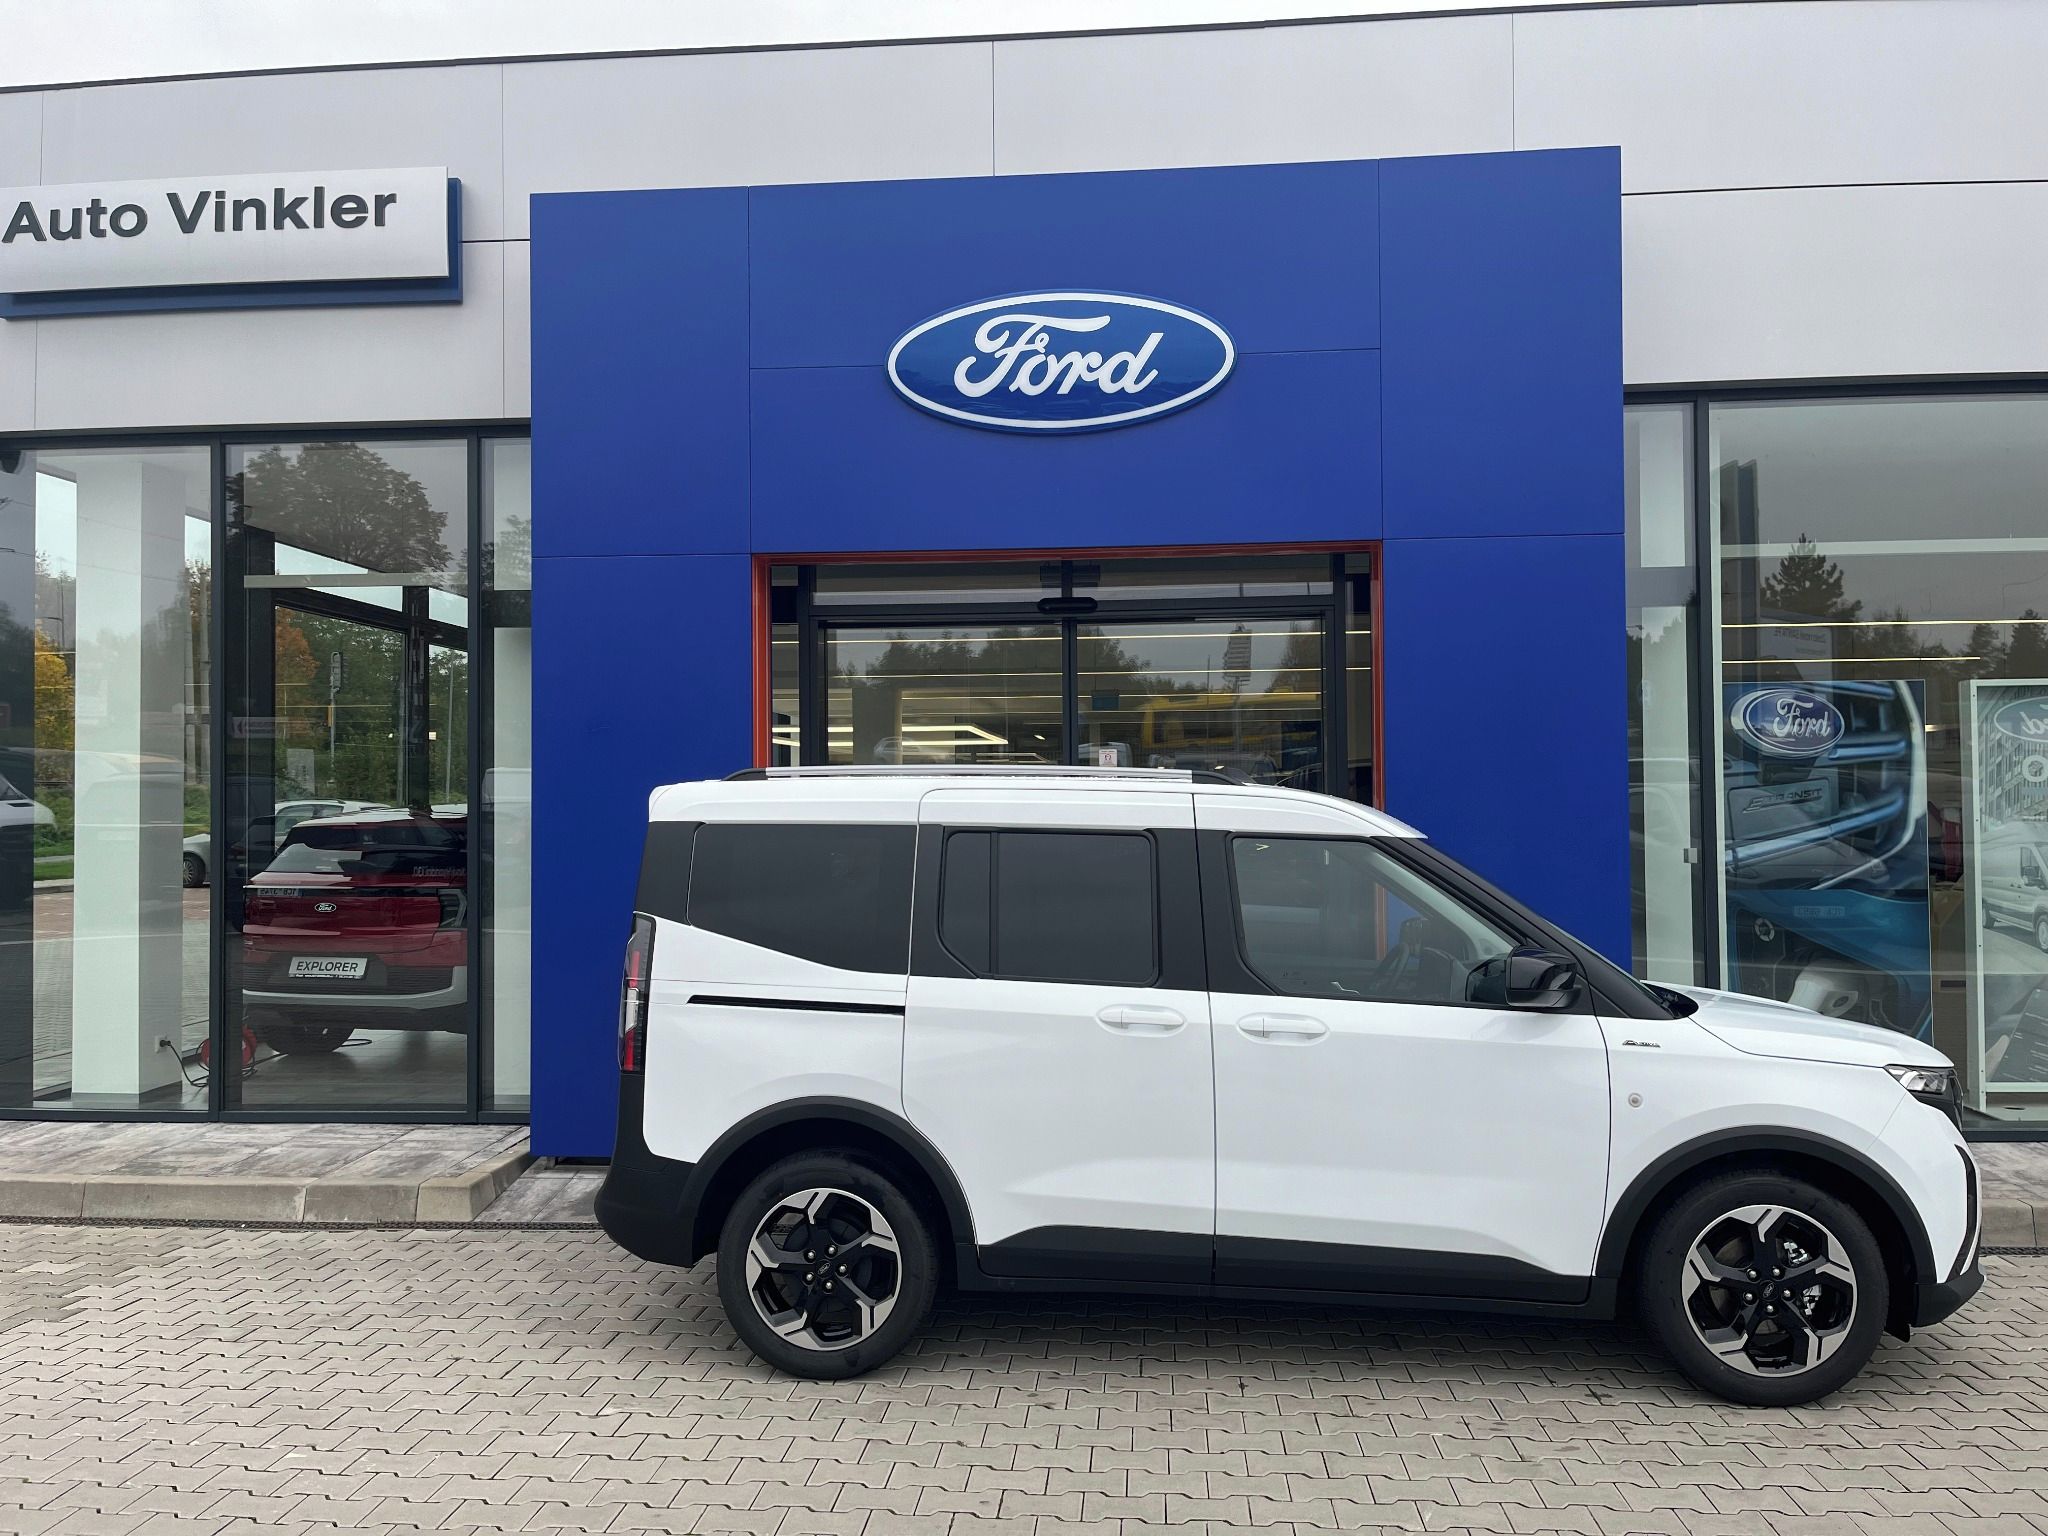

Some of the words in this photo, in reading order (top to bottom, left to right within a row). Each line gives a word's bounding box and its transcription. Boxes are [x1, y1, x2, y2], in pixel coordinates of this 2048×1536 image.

[2, 197, 148, 243] Auto
[166, 185, 397, 234] Vinkler
[953, 313, 1165, 398] Ford
[1773, 698, 1831, 738] Ford
[296, 961, 359, 972] EXPLORER
